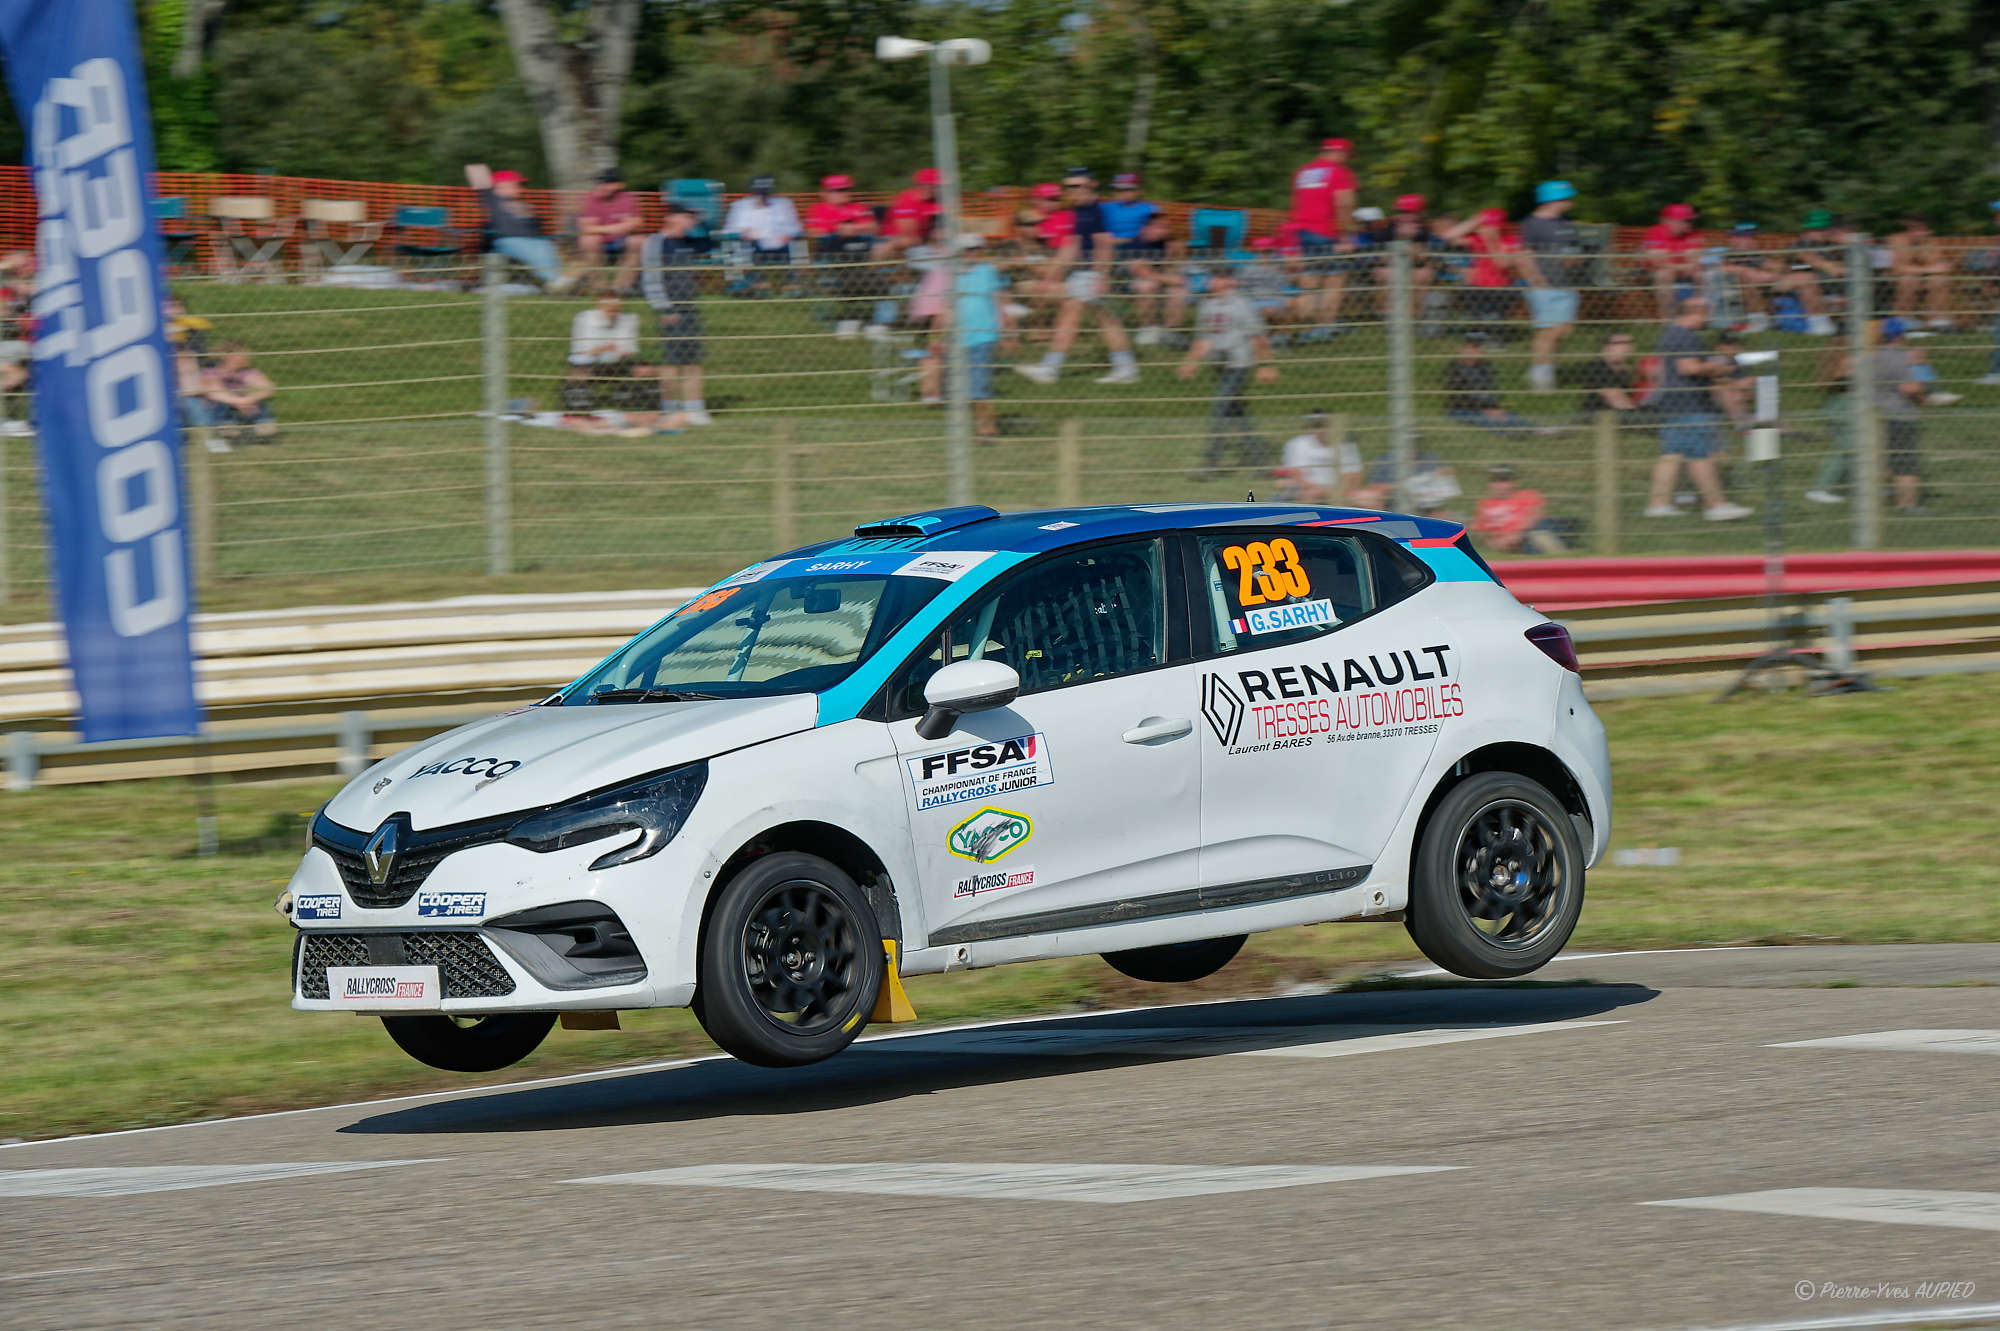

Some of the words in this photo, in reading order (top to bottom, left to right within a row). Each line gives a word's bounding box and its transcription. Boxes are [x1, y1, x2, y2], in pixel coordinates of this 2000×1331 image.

[805, 560, 873, 572] SARHY
[1223, 538, 1311, 607] 233
[1251, 601, 1329, 632] G.SARHY
[1238, 645, 1450, 703] RENAULT
[1252, 698, 1330, 740] TRESSES
[1336, 683, 1464, 731] AUTOMOBILES
[1404, 724, 1439, 736] TRESSES
[1228, 741, 1271, 755] Laurent
[1273, 737, 1313, 750] BARES
[407, 757, 521, 779] YACCO
[922, 740, 1026, 780] FFSA
[922, 776, 985, 796] CHAMPIONNAT
[988, 773, 1000, 783] DE
[1002, 766, 1037, 779] FRANCE
[922, 783, 997, 808] RALLYCROSS
[998, 776, 1037, 792] JUNIOR
[1008, 872, 1032, 886] FRANCE
[1314, 870, 1358, 883] CLIO
[298, 896, 340, 909] COOPER
[420, 894, 485, 906] COOPER
[447, 905, 482, 914] TIRES
[316, 908, 339, 917] TIRES
[346, 977, 396, 995] RALLYCROSS
[398, 983, 423, 997] FRANCE
